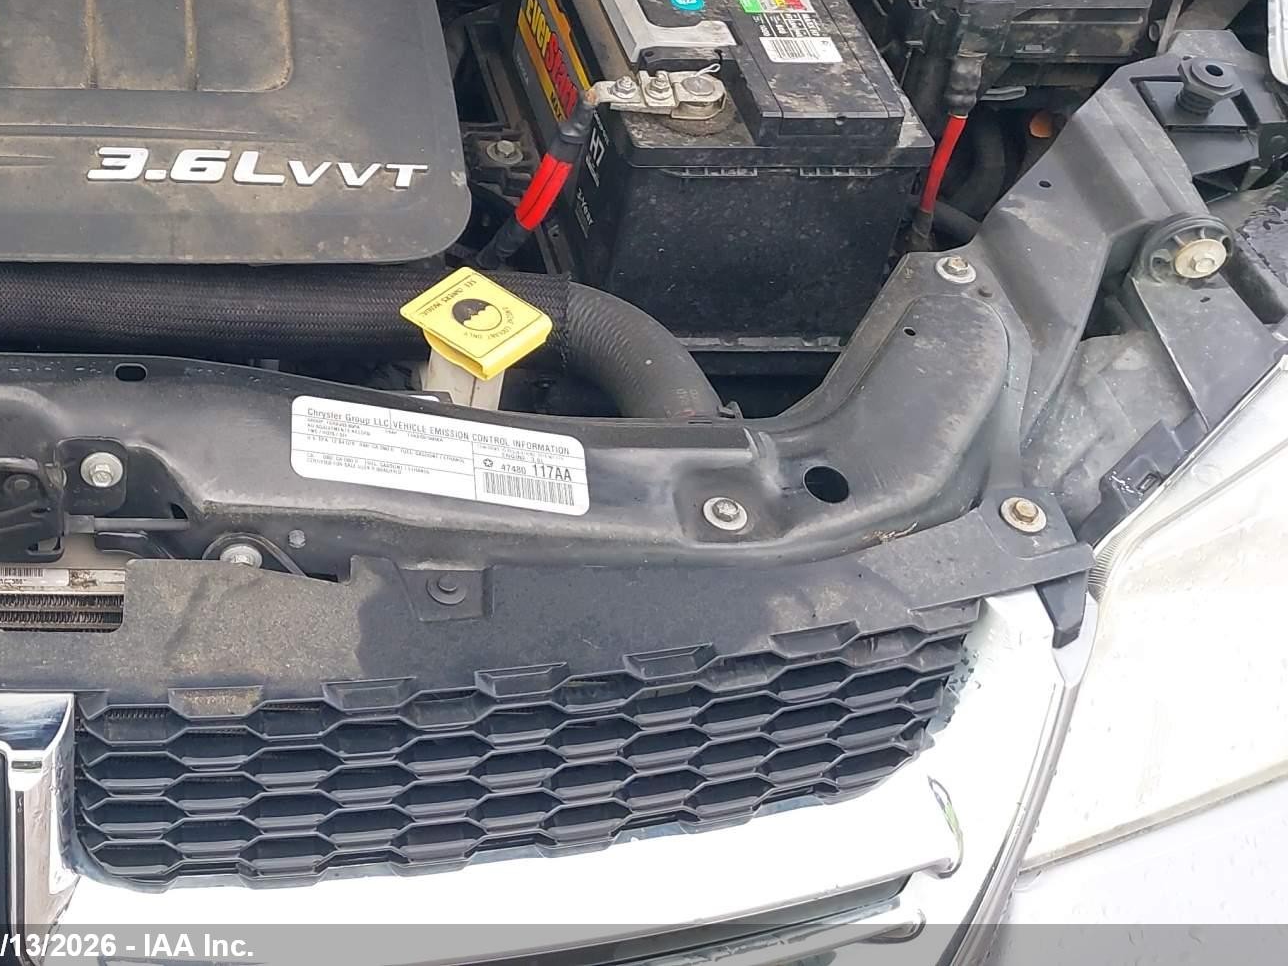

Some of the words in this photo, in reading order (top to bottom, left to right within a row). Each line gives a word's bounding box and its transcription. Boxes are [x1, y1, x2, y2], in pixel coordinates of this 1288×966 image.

[307, 407, 343, 420] Chrysler
[345, 413, 371, 425] Group
[373, 418, 389, 427] LLC
[393, 421, 427, 433] VEHICLE
[430, 426, 469, 441] EMISSION
[472, 433, 509, 447] CONTROL
[512, 439, 570, 455] INFORMATION
[500, 463, 527, 475] 47480
[533, 464, 573, 482] 117AA
